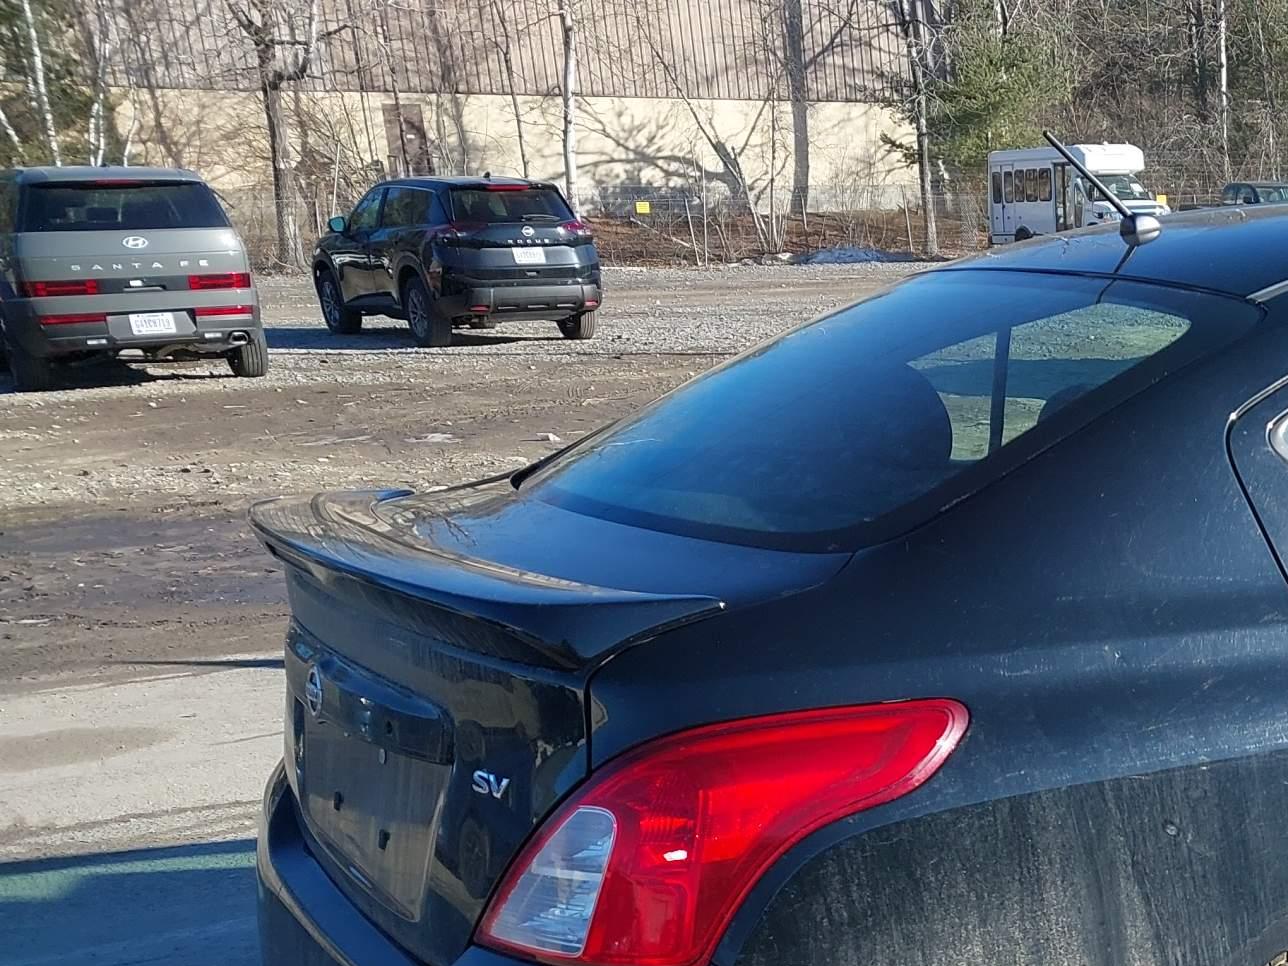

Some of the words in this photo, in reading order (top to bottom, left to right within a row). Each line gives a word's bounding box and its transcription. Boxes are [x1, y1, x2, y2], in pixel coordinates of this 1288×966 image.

[71, 262, 164, 271] SANTA
[179, 259, 209, 267] FE
[471, 770, 510, 799] SV
